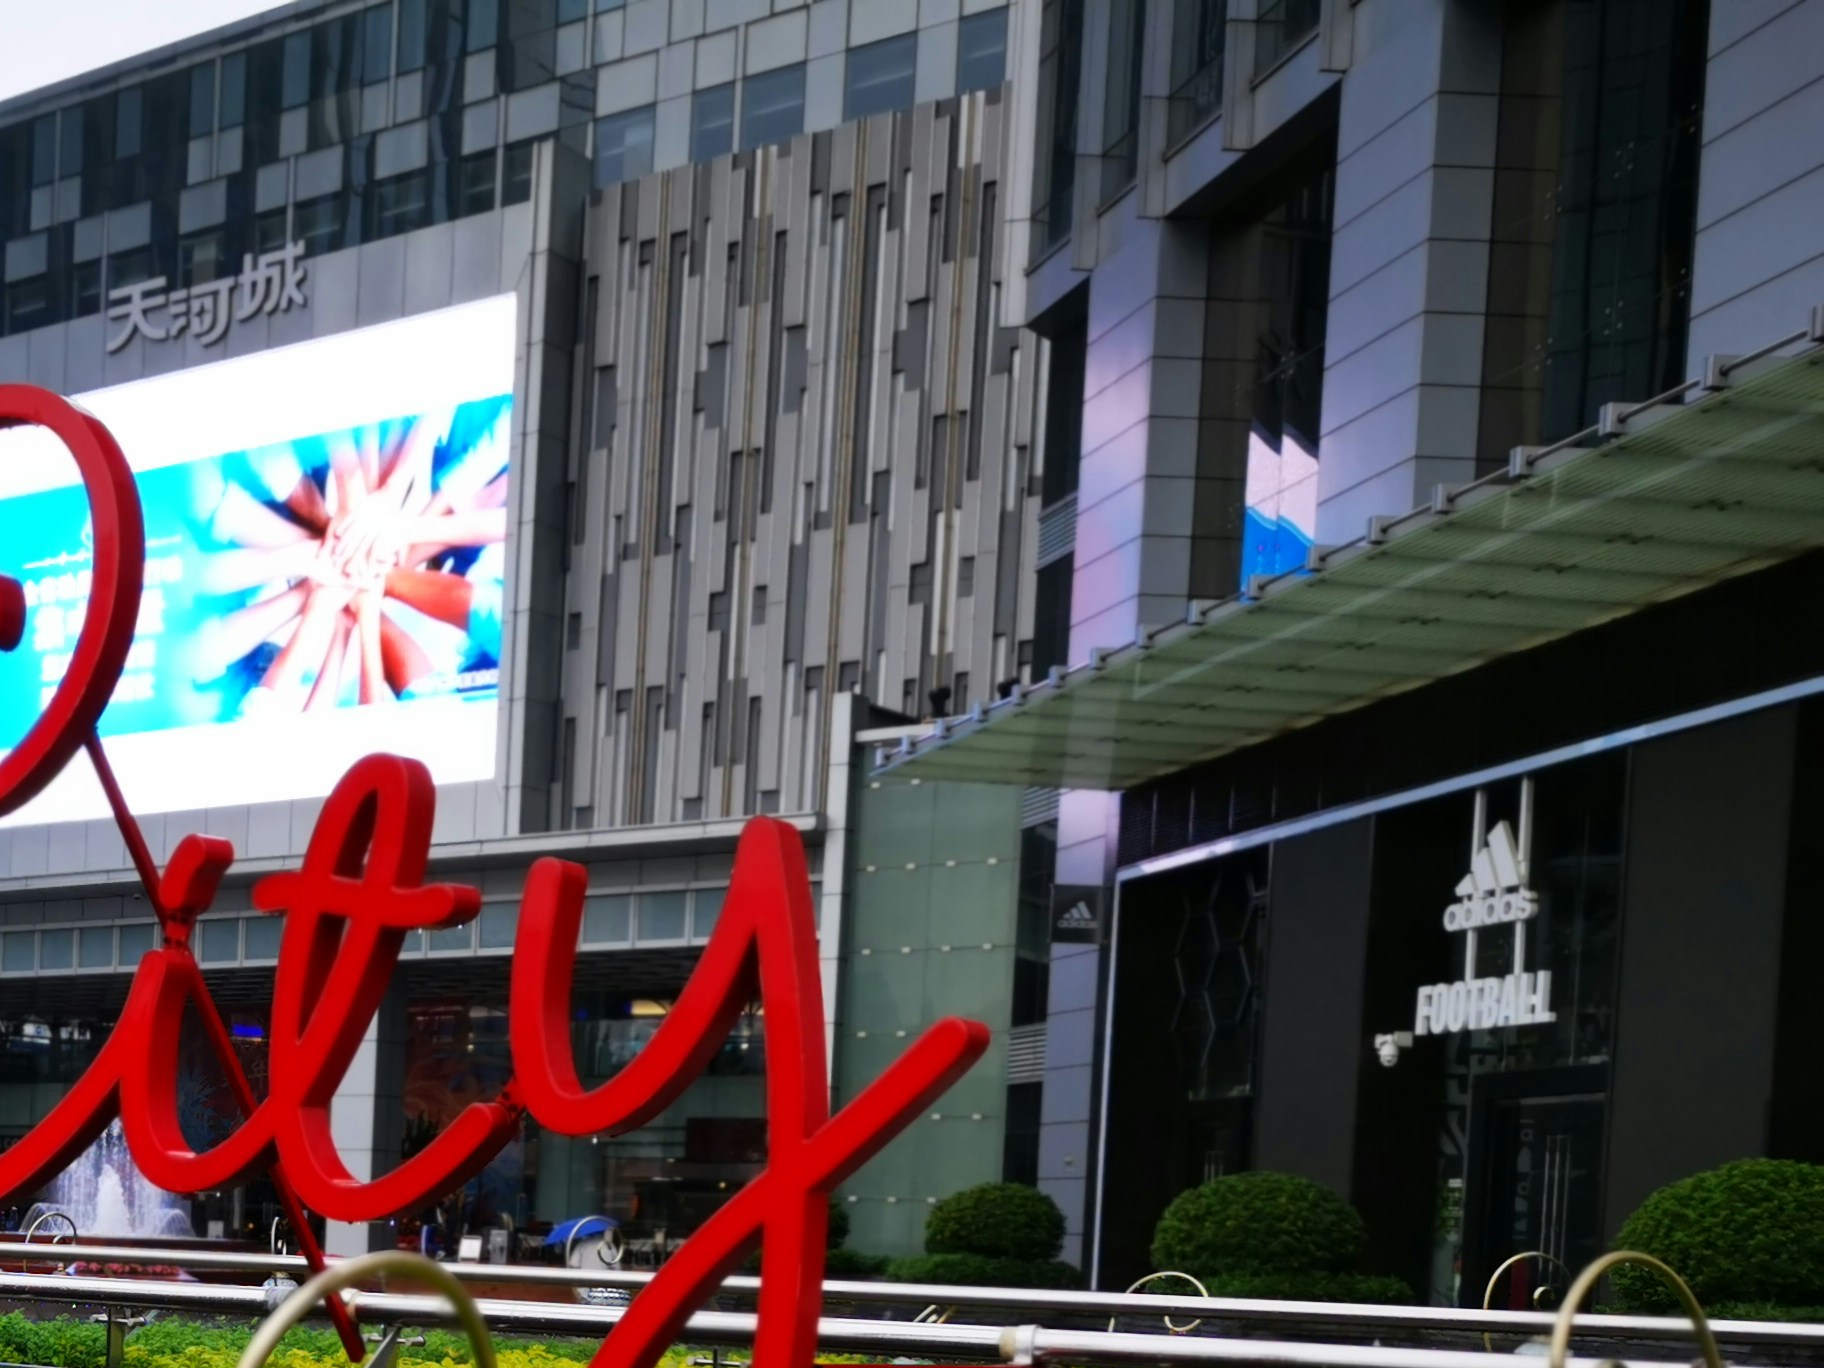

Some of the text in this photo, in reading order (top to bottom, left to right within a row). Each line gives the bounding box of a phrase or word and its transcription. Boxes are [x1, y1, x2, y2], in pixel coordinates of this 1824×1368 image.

[105, 240, 307, 354] 天河城
[1442, 886, 1539, 933] adidas
[1415, 969, 1557, 1036] FOOTBALL
